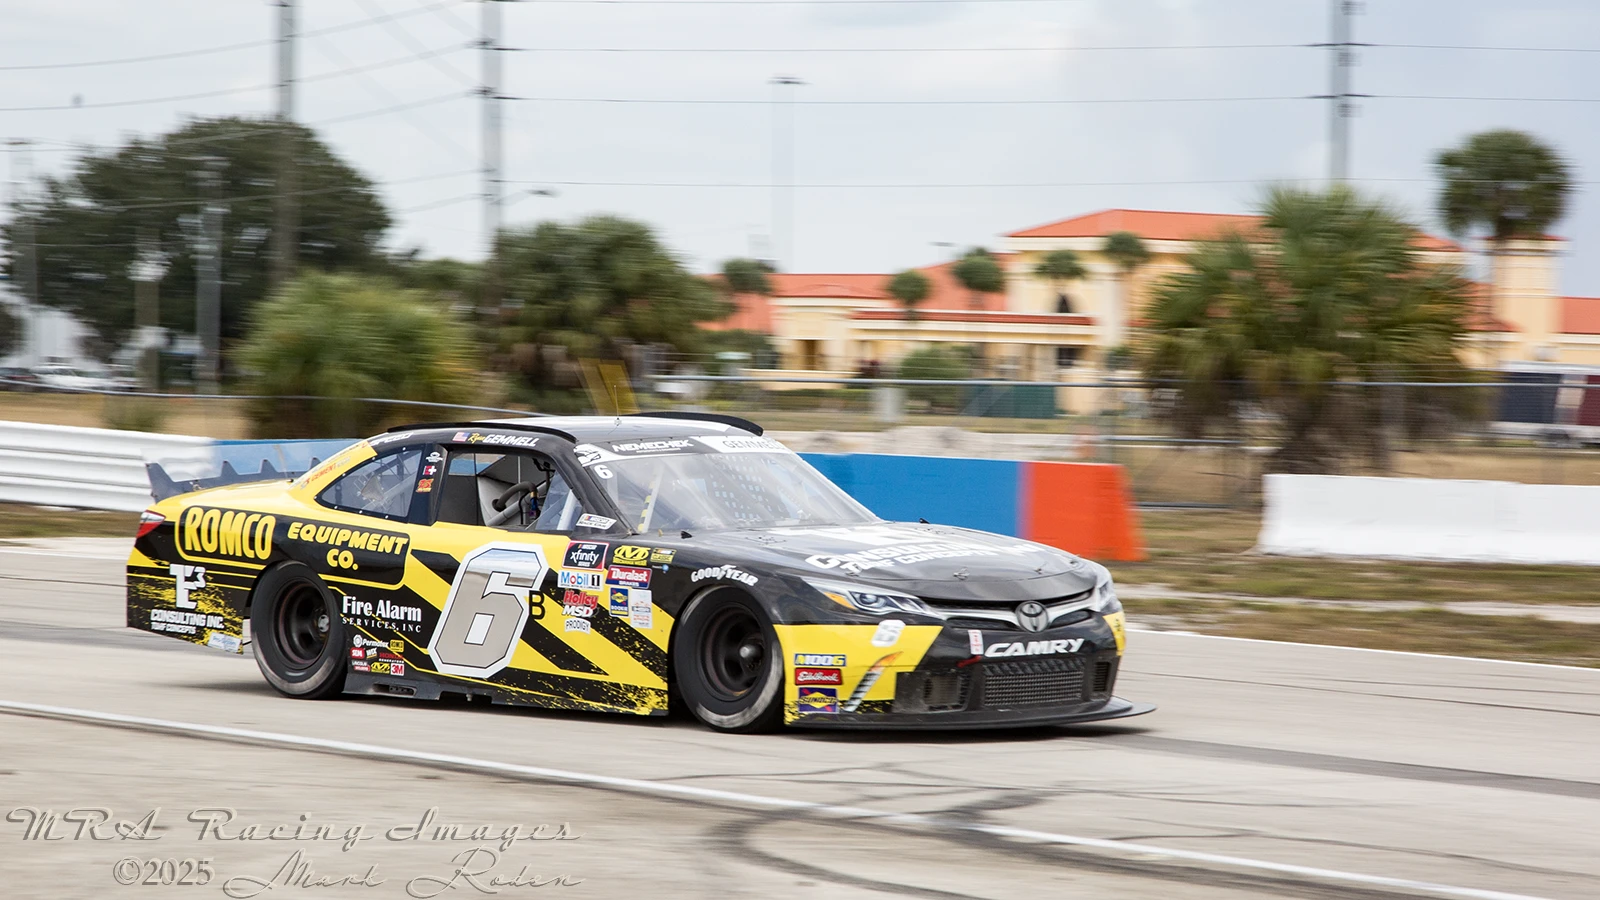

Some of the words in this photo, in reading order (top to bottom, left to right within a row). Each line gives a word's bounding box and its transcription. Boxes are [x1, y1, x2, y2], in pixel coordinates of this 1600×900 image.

[483, 433, 539, 447] GEMMELL
[612, 440, 694, 453] NEMECHEK
[594, 464, 613, 479] 6
[185, 507, 276, 560] ROMCO
[287, 522, 408, 555] EQUIPMENT
[326, 548, 358, 571] CO.
[570, 549, 600, 565] xfinity
[560, 571, 589, 586] Mobil
[610, 567, 648, 582] Duralast
[342, 596, 373, 616] Fire
[376, 599, 422, 622] Alarm
[430, 544, 546, 675] 6
[528, 590, 545, 620] B
[562, 604, 593, 618] MSD
[151, 609, 206, 627] CONSULTING
[206, 615, 225, 629] INC.
[984, 638, 1085, 657] CAMRY
[391, 664, 404, 675] 3M
